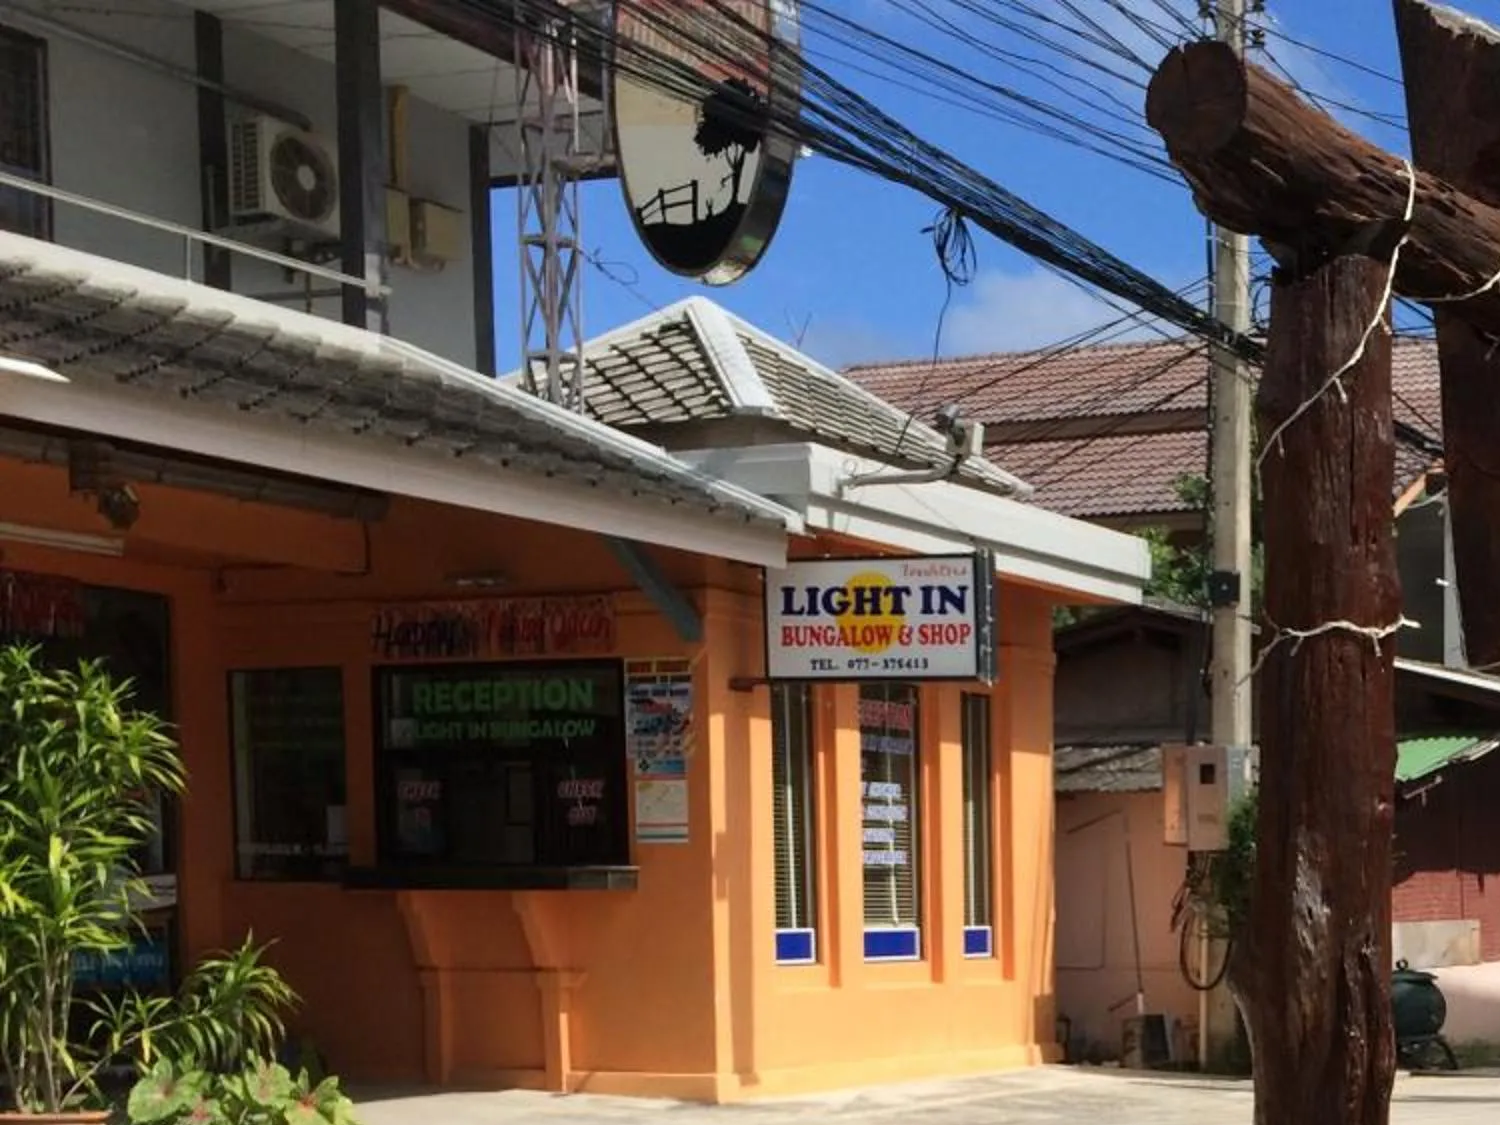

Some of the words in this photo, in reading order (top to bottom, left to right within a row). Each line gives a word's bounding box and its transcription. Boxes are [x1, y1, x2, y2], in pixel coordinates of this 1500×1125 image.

[781, 586, 911, 617] LIGHT
[920, 585, 969, 615] IN
[781, 624, 893, 647] BUNGALOW
[898, 625, 914, 646] &
[919, 623, 971, 645] SHOP
[412, 677, 594, 714] RECEPTION
[415, 721, 463, 740] LIGHT
[469, 721, 487, 738] IN
